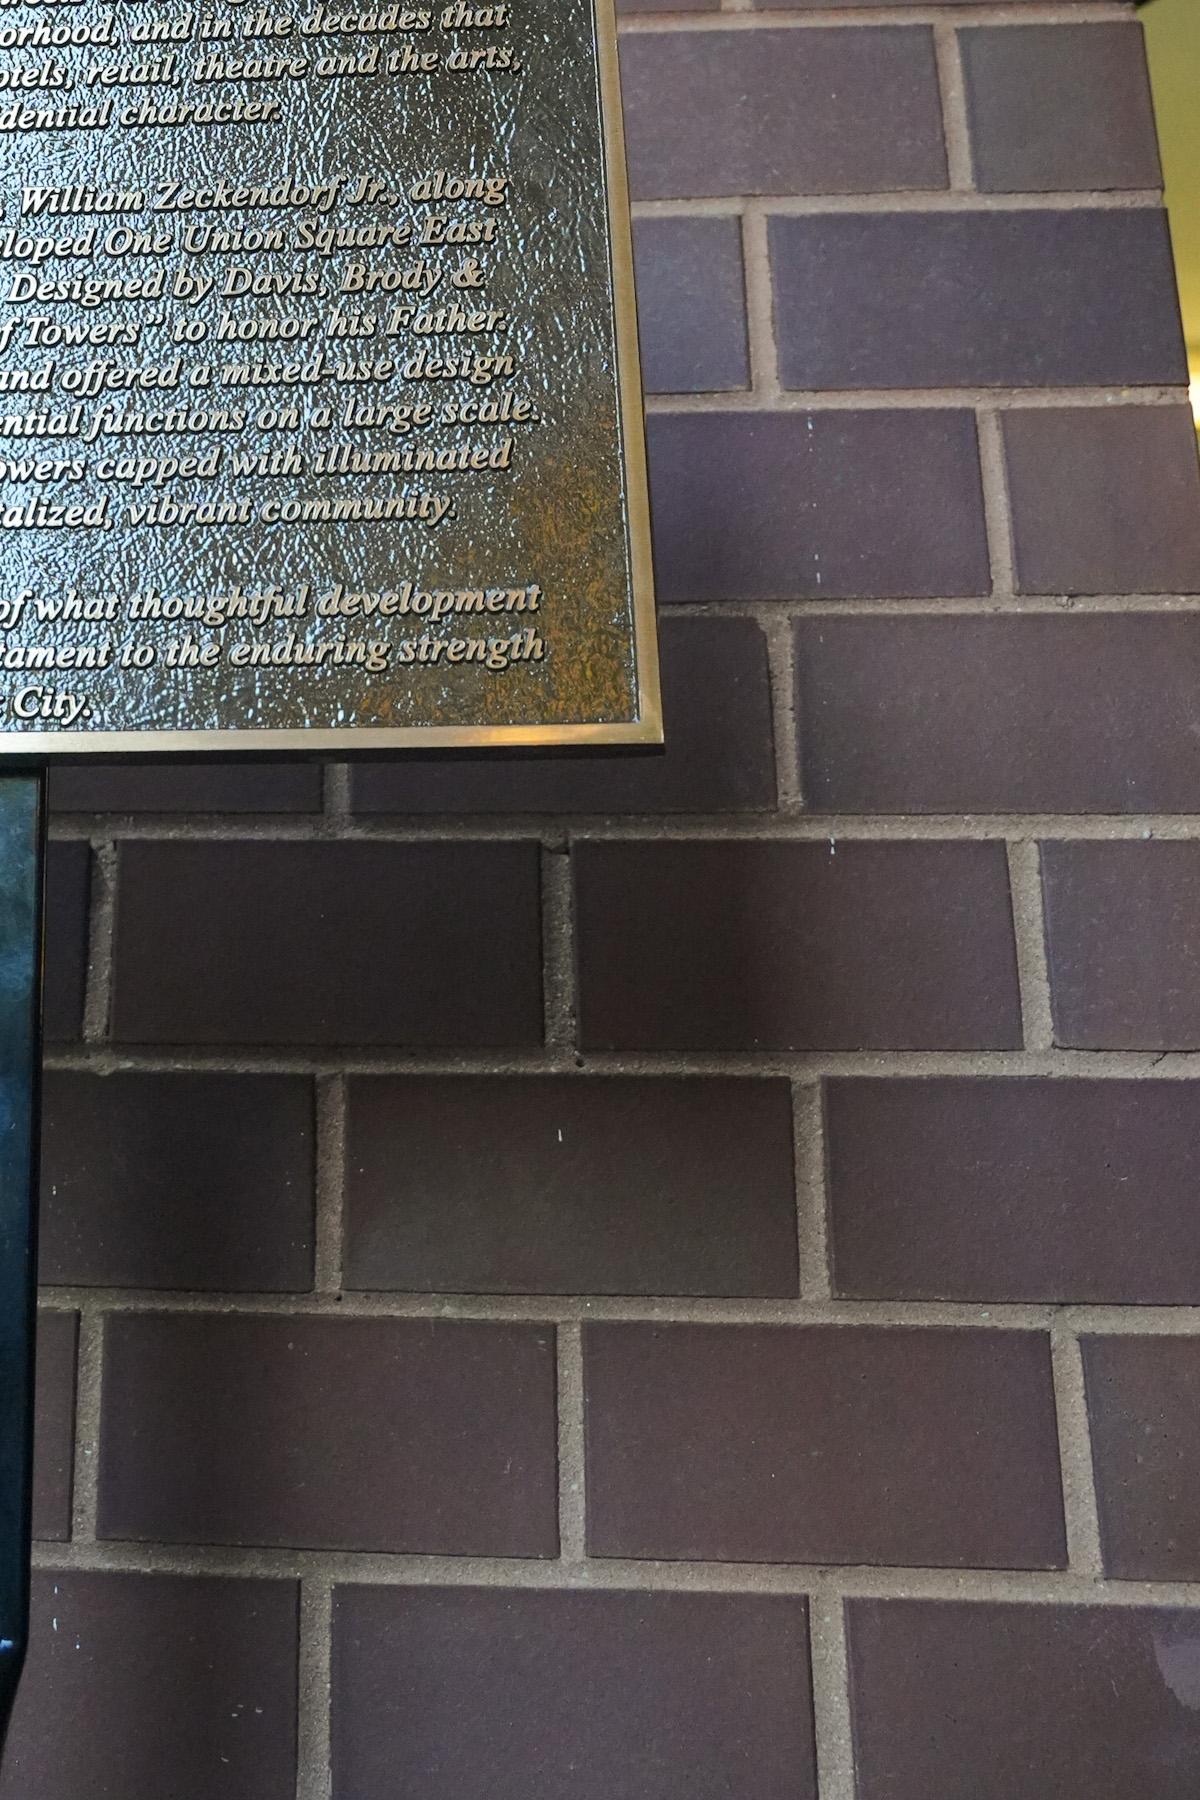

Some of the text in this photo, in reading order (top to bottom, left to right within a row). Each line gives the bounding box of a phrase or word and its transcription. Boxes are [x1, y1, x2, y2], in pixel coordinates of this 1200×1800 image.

[131, 13, 192, 41] and
[200, 12, 232, 39] in
[243, 10, 293, 36] the
[302, 5, 431, 35] decades
[441, 3, 508, 29] that
[87, 56, 182, 86] retail,
[193, 51, 307, 79] theatre
[315, 47, 379, 75] and
[388, 46, 439, 72] the
[448, 46, 523, 72] arts,
[120, 97, 283, 128] character.
[21, 185, 145, 213] William
[154, 174, 345, 212] Zeckendorf
[347, 176, 399, 206] Jr.,
[411, 171, 508, 206] along
[105, 228, 172, 256] One
[184, 225, 284, 253] Union
[295, 219, 411, 255] Square
[421, 217, 499, 243] East
[6, 270, 166, 305] Designed
[172, 267, 214, 302] by
[221, 267, 331, 297] Davis,
[340, 261, 443, 295] Brody
[452, 258, 485, 288] &
[173, 318, 209, 344] to
[217, 310, 318, 339] honor
[327, 308, 377, 338] his
[386, 305, 508, 334] Father.
[61, 359, 181, 395] offered
[190, 366, 213, 386] a
[221, 353, 394, 384] mixed-use
[403, 352, 515, 384] design
[85, 403, 246, 442] functions
[258, 404, 301, 430] on
[311, 404, 332, 427] a
[343, 398, 433, 433] large
[442, 392, 542, 422] scale.
[96, 445, 221, 487] capped
[230, 446, 303, 477] with
[315, 439, 513, 474] illuminated
[126, 496, 252, 526] vibrant
[260, 491, 457, 527] community.
[33, 592, 118, 622] what
[129, 583, 309, 627] thoughtful
[316, 582, 541, 622] development
[120, 642, 156, 668] to
[165, 636, 221, 667] the
[228, 635, 391, 672] enduring
[401, 629, 546, 669] strength
[14, 687, 92, 725] City.
